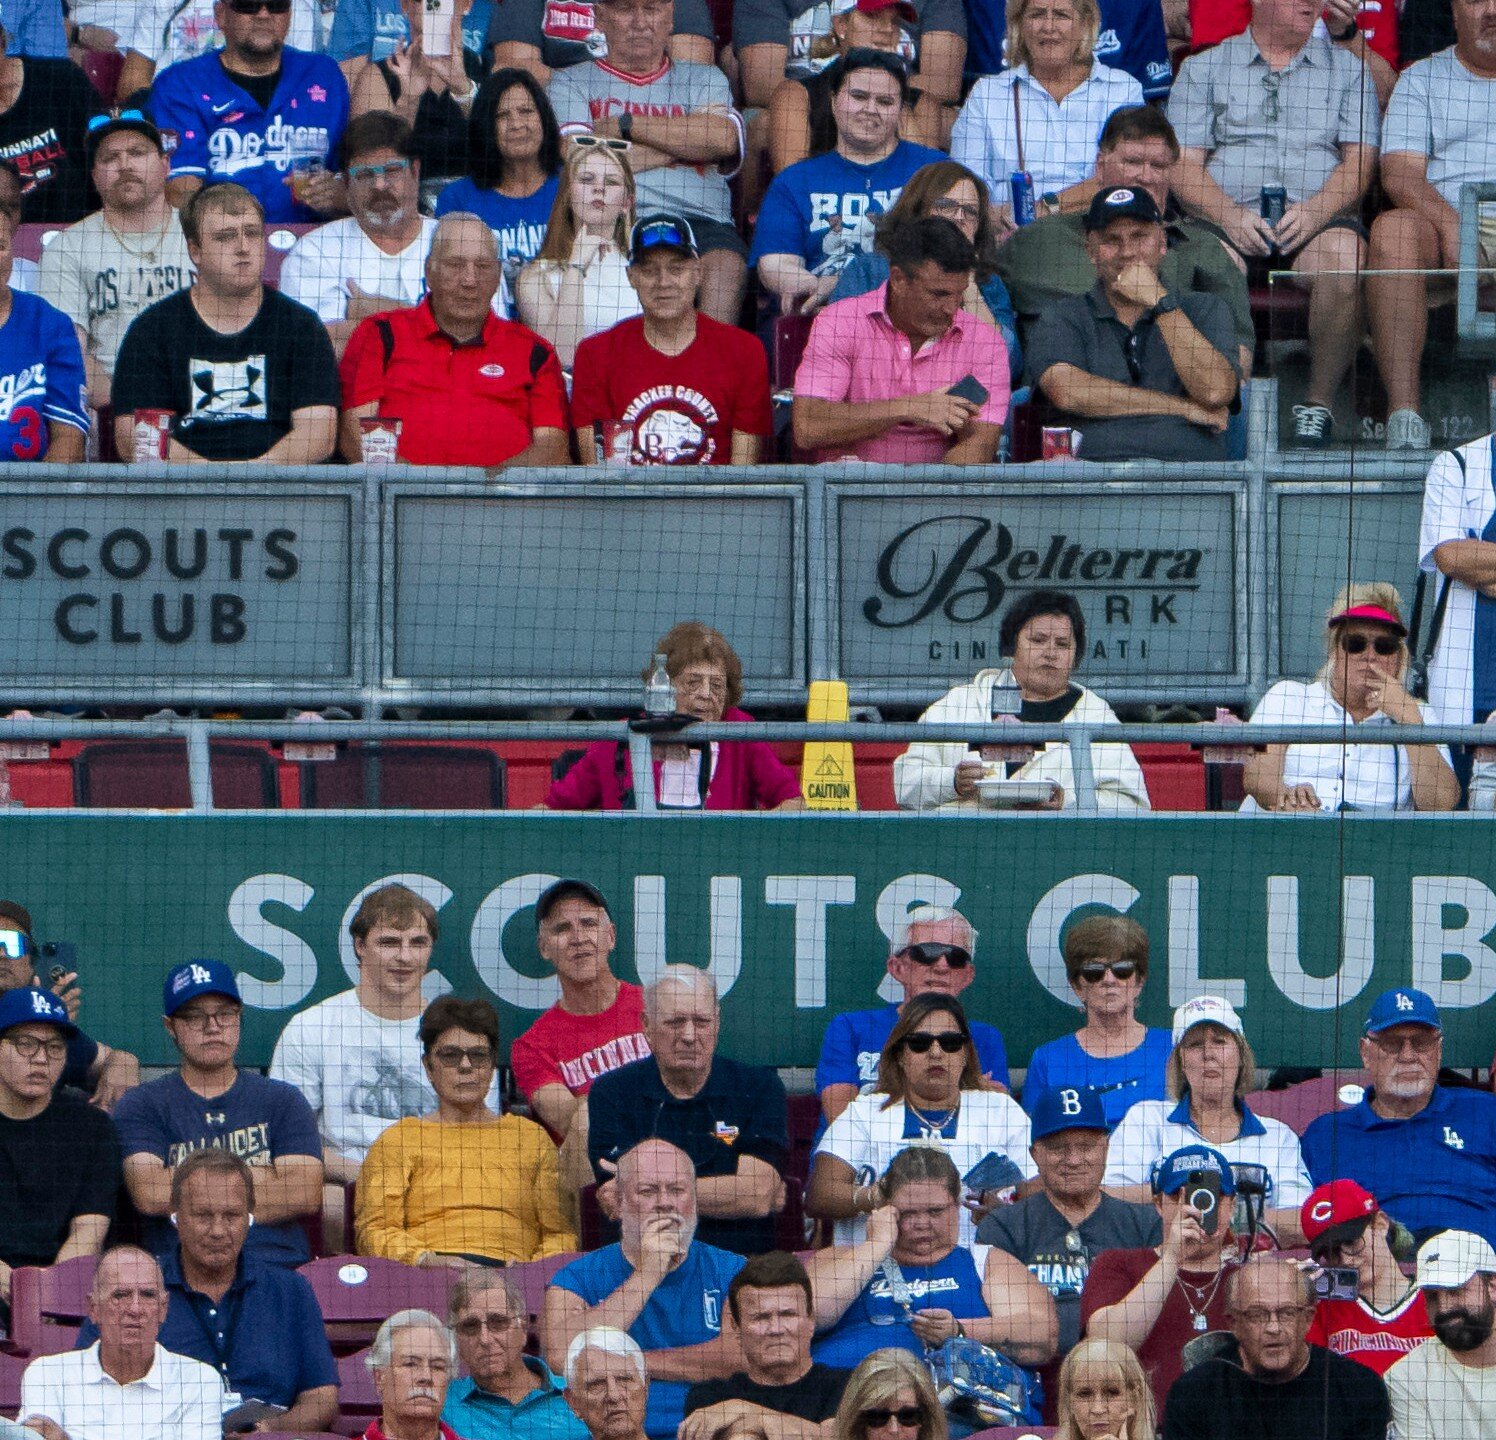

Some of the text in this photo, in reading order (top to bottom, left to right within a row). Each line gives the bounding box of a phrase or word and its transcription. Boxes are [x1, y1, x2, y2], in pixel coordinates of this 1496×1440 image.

[376, 11, 408, 35] LOS
[8, 405, 41, 461] 3
[1, 527, 300, 581] SCOUTS
[863, 515, 1203, 628] Belterra
[54, 594, 249, 645] CLUB
[929, 639, 1149, 660] CINATI
[807, 783, 850, 798] CAUTION
[190, 963, 212, 984] LA
[30, 991, 52, 1015] LA
[1394, 992, 1414, 1011] LA
[1060, 1088, 1082, 1115] B
[1443, 1126, 1465, 1150] LA
[1311, 1200, 1333, 1222] C
